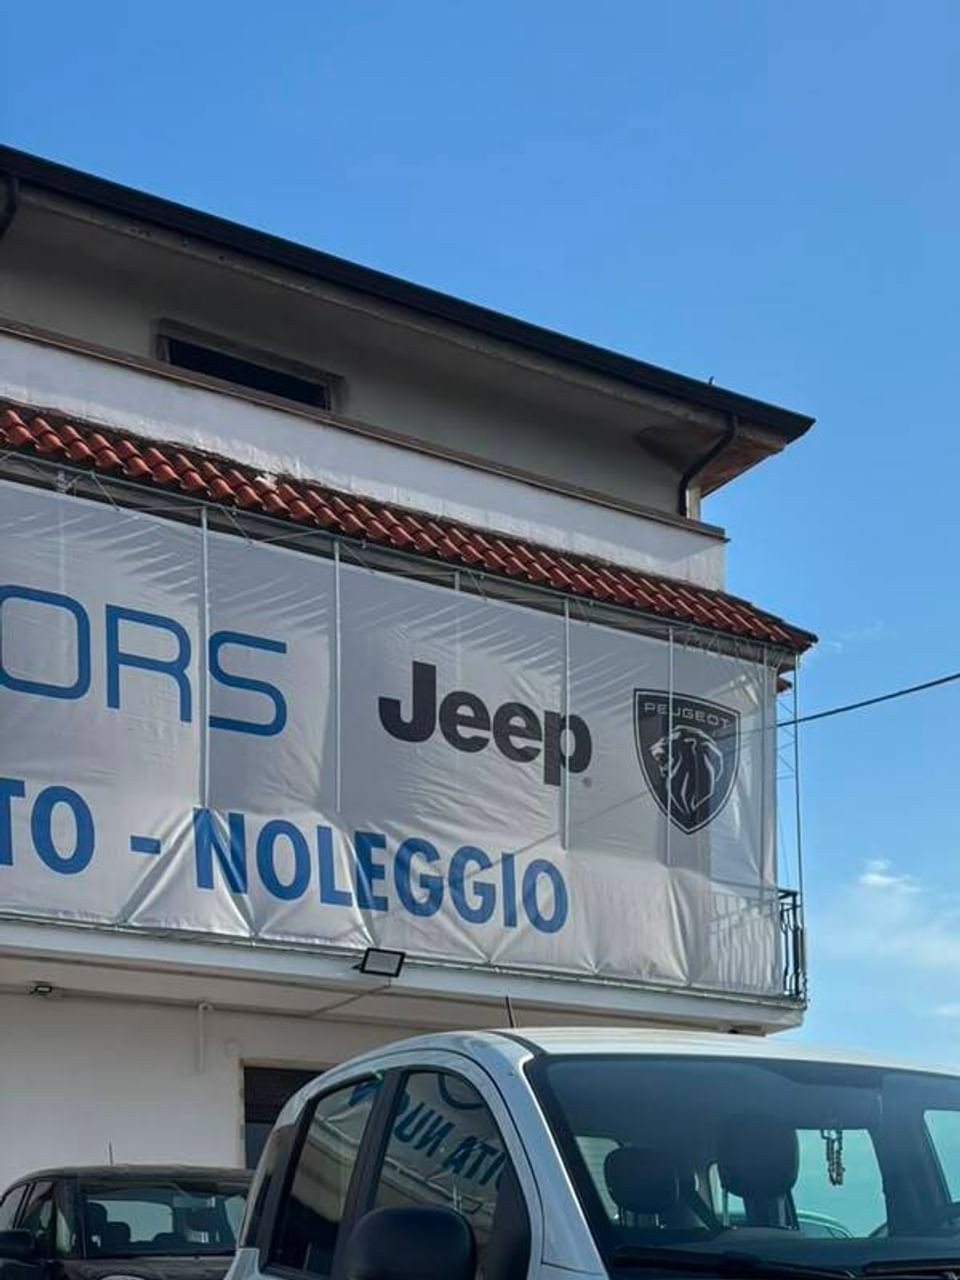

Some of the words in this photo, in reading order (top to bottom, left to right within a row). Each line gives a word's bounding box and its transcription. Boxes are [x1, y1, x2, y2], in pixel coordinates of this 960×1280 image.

[378, 660, 592, 785] Jeep
[644, 702, 731, 729] PEUGEOT
[193, 806, 568, 934] NOLEGGIO
